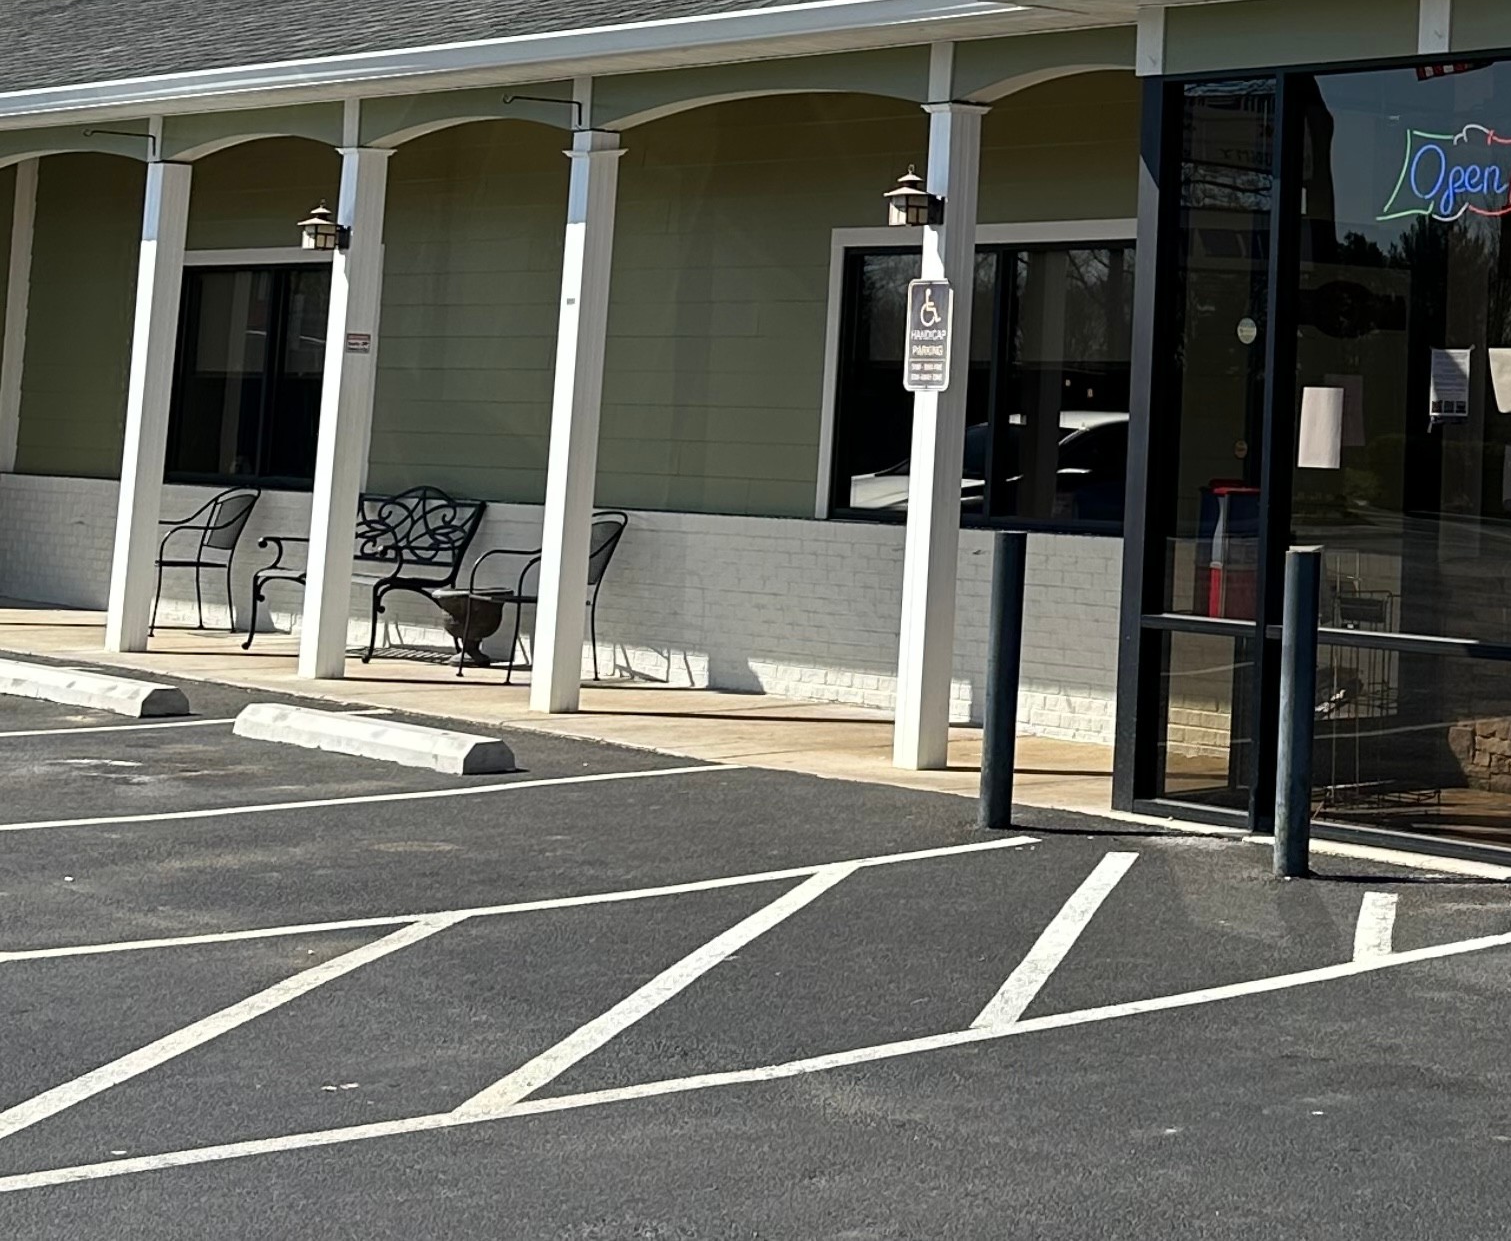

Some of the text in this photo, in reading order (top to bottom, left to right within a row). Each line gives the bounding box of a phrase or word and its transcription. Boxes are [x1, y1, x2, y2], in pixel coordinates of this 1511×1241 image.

[1410, 144, 1509, 215] Open
[910, 329, 946, 340] HANDICAP
[912, 345, 944, 356] PARKING
